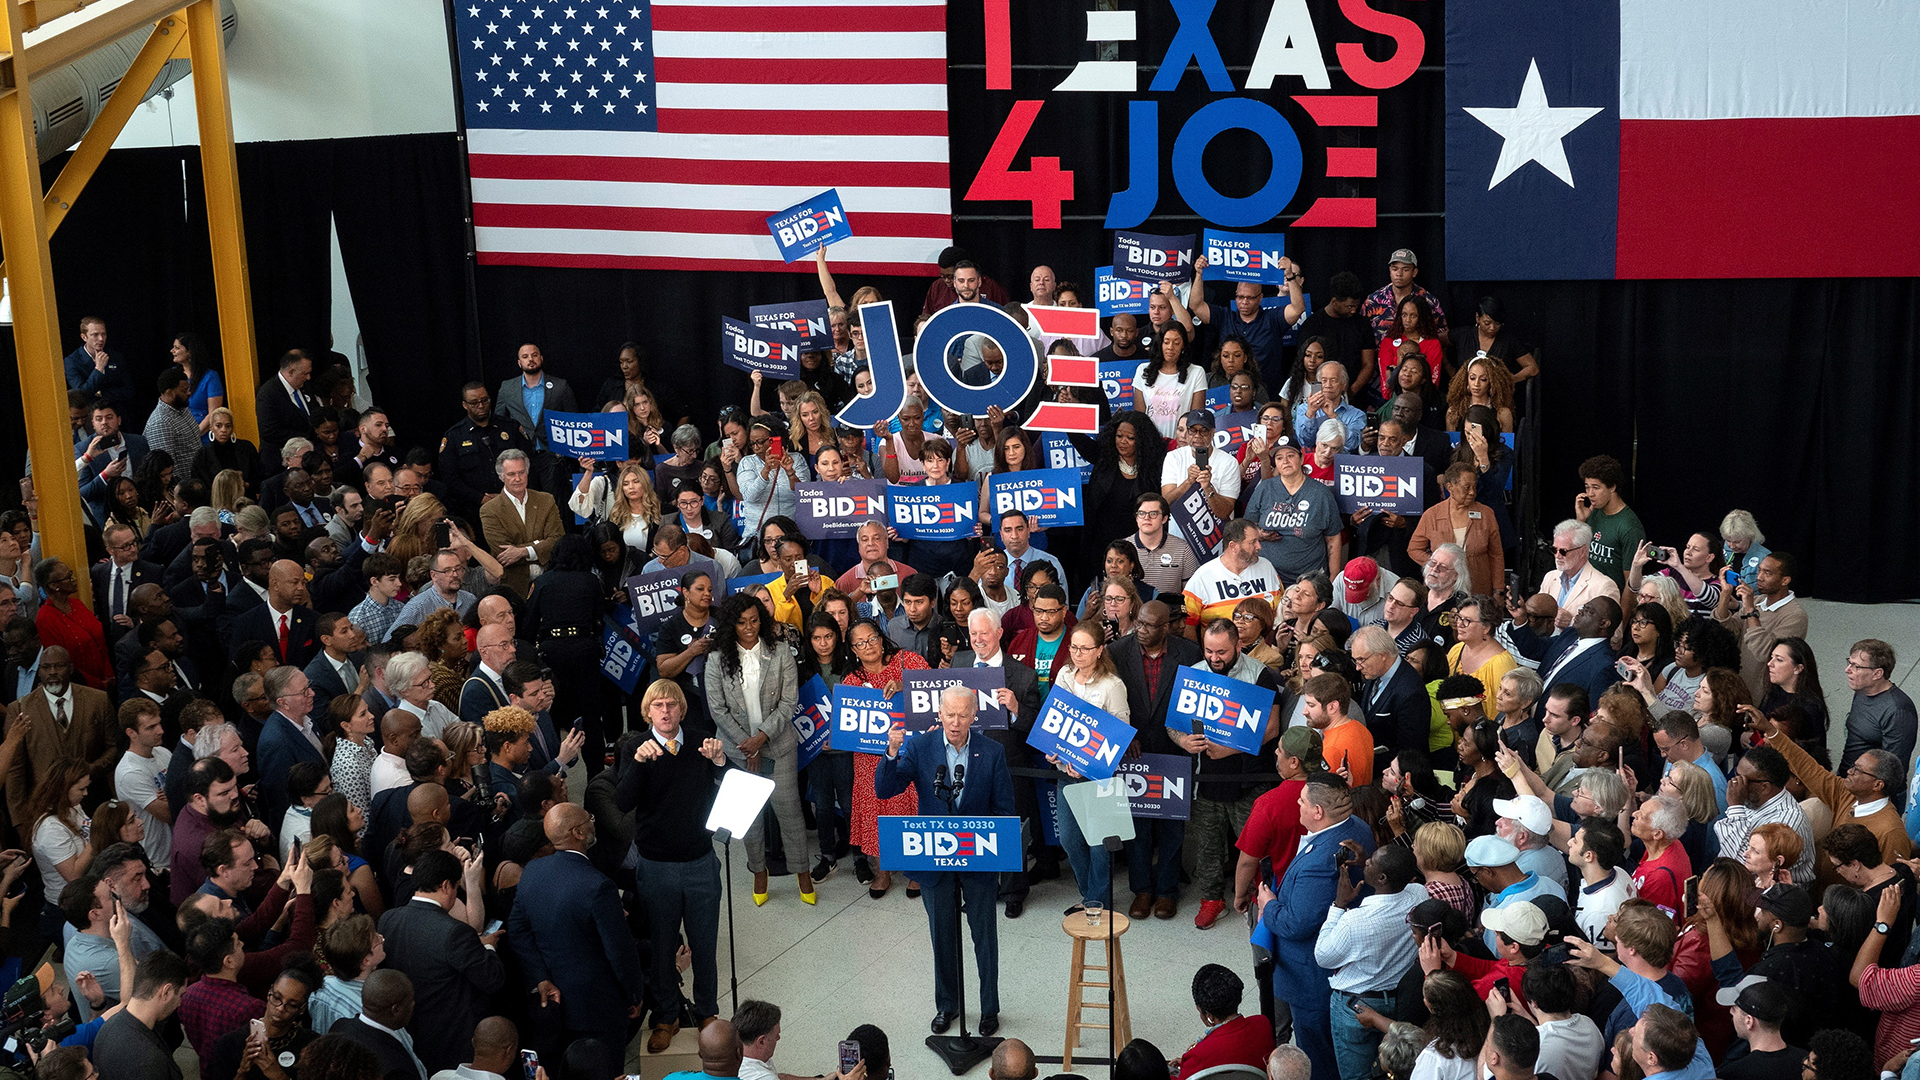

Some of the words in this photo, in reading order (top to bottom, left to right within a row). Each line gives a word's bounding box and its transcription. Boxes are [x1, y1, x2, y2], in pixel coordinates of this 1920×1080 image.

[963, 100, 1074, 229] 4
[1103, 96, 1378, 229] JOE
[774, 214, 798, 229] TEXAS
[799, 208, 814, 218] FOR
[778, 206, 843, 248] BIDEN
[1118, 237, 1140, 246] Todos
[1209, 239, 1232, 247] TEXAS
[1128, 246, 1192, 267] BIDEN
[1208, 247, 1279, 269] BIDEN
[725, 322, 744, 334] Todos
[755, 314, 778, 322] TEXAS
[735, 334, 798, 361] BIDEN
[834, 300, 1100, 434] JOE
[550, 418, 575, 428] TEXAS
[551, 426, 622, 448] BIDEN
[1340, 465, 1365, 473] TEXAS
[996, 481, 1024, 491] TEXAS
[1025, 480, 1043, 488] FOR
[1340, 474, 1416, 498] BIDEN
[812, 495, 885, 517] BIDEN
[996, 488, 1076, 514] BIDEN
[894, 501, 973, 524] BIDEN
[1183, 490, 1224, 556] BIDEN
[1265, 512, 1309, 527] COOGS!
[1589, 541, 1614, 558] SUIT
[635, 582, 659, 595] TEXAS
[660, 578, 678, 588] FOR
[637, 587, 681, 617] BID
[1183, 678, 1210, 692] TEXAS
[1211, 686, 1230, 698] FOR
[841, 697, 872, 708] TEXAS
[874, 701, 893, 710] FOR
[911, 689, 1000, 713] BIN
[1176, 688, 1262, 733] BIDEN
[794, 695, 832, 744] DEN
[840, 707, 911, 736] BIDE
[1053, 698, 1080, 718] TEXAS
[1080, 713, 1099, 728] FOR
[1041, 707, 1120, 767] BIDEN
[1130, 764, 1149, 772] FOR
[1097, 774, 1184, 800] BIDEN
[1047, 790, 1058, 808] FOR
[902, 821, 926, 829] Text
[963, 821, 995, 829] 30330
[902, 832, 998, 856] BIDEN
[934, 858, 968, 866] TEXAS
